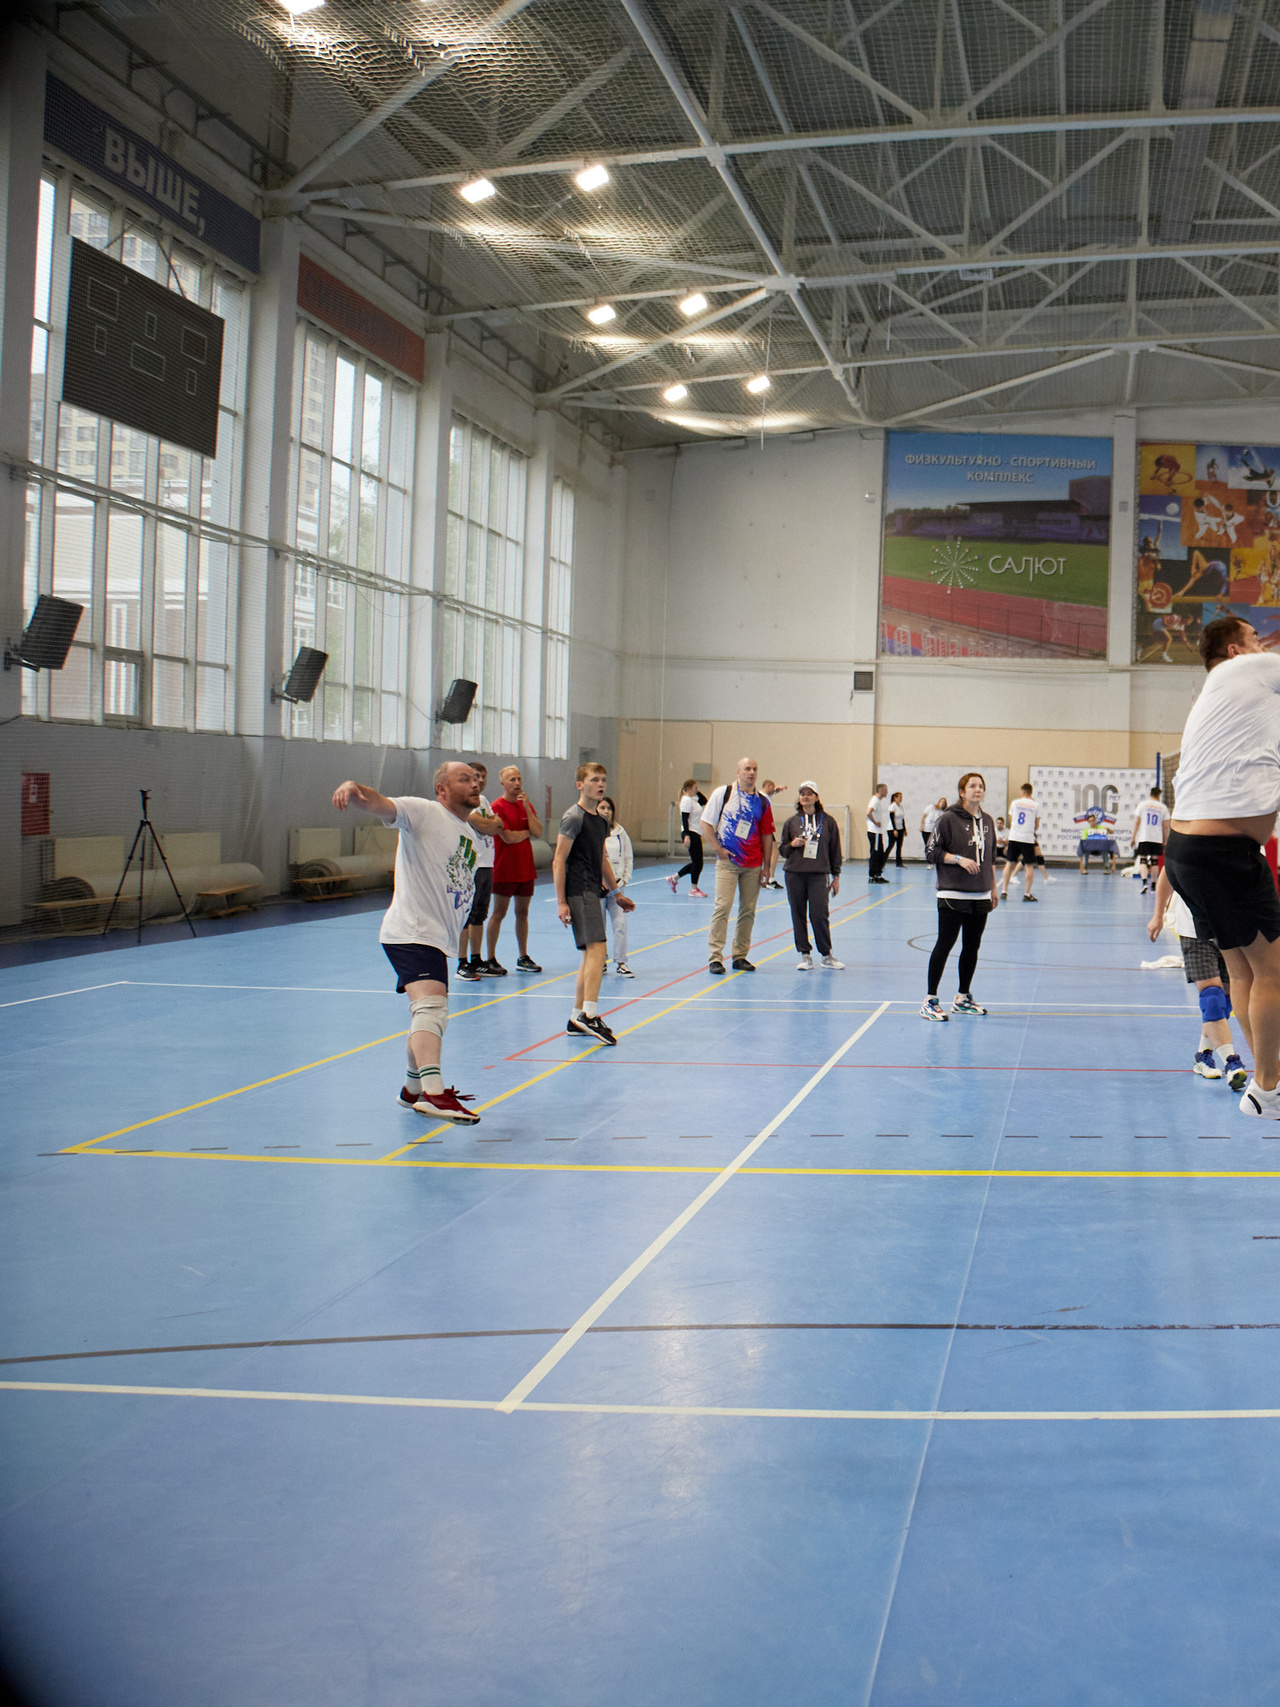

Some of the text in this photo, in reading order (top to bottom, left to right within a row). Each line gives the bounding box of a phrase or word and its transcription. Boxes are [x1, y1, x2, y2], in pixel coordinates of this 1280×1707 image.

[103, 123, 205, 235] ВЫШЕ,
[904, 453, 1001, 467] ФИЗКУЛЬТУРНО
[1010, 456, 1096, 470] СПОРТИВНЫЙ
[967, 471, 1033, 483] КОМПЛЕКС
[988, 555, 1067, 582] САЛЮТ
[1017, 811, 1026, 825] 8
[1146, 813, 1159, 826] 10
